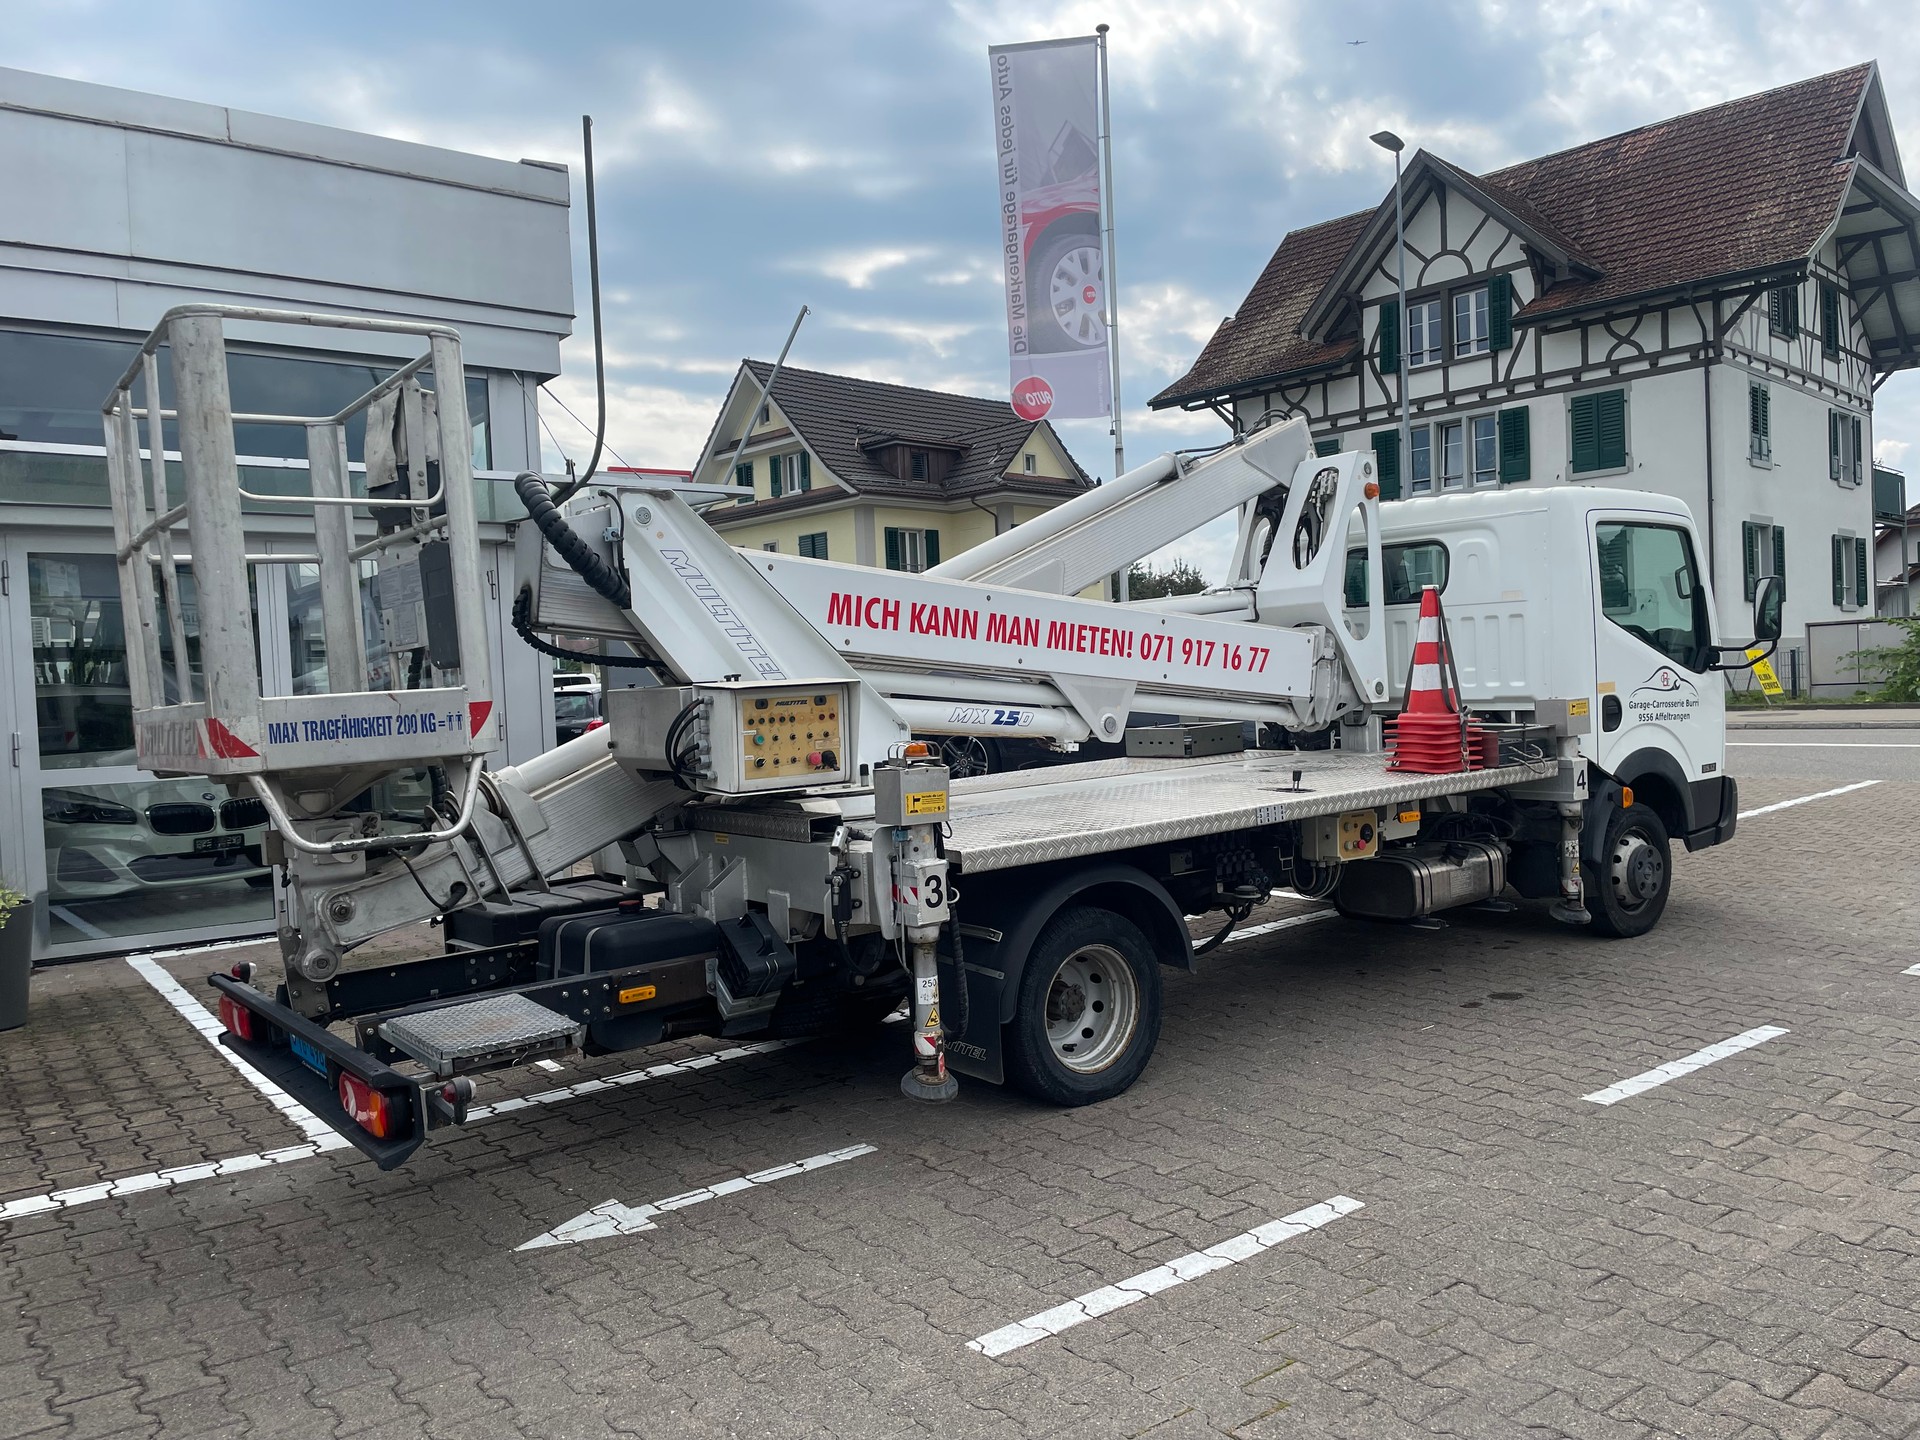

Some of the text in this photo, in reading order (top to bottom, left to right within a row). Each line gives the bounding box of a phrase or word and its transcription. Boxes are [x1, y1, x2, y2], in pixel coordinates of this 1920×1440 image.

[827, 592, 1270, 673] MICH KANN MAN MIETEN! 071 917 16 77
[1685, 698, 1699, 708] Burri
[948, 707, 989, 724] MX
[1638, 712, 1691, 722] 9556 Affeltrangen
[268, 721, 299, 745] MAX
[302, 714, 393, 742] TRAGFÄHIGKEIT
[396, 714, 418, 736] 200
[1576, 769, 1587, 790] 4
[924, 875, 944, 909] 3
